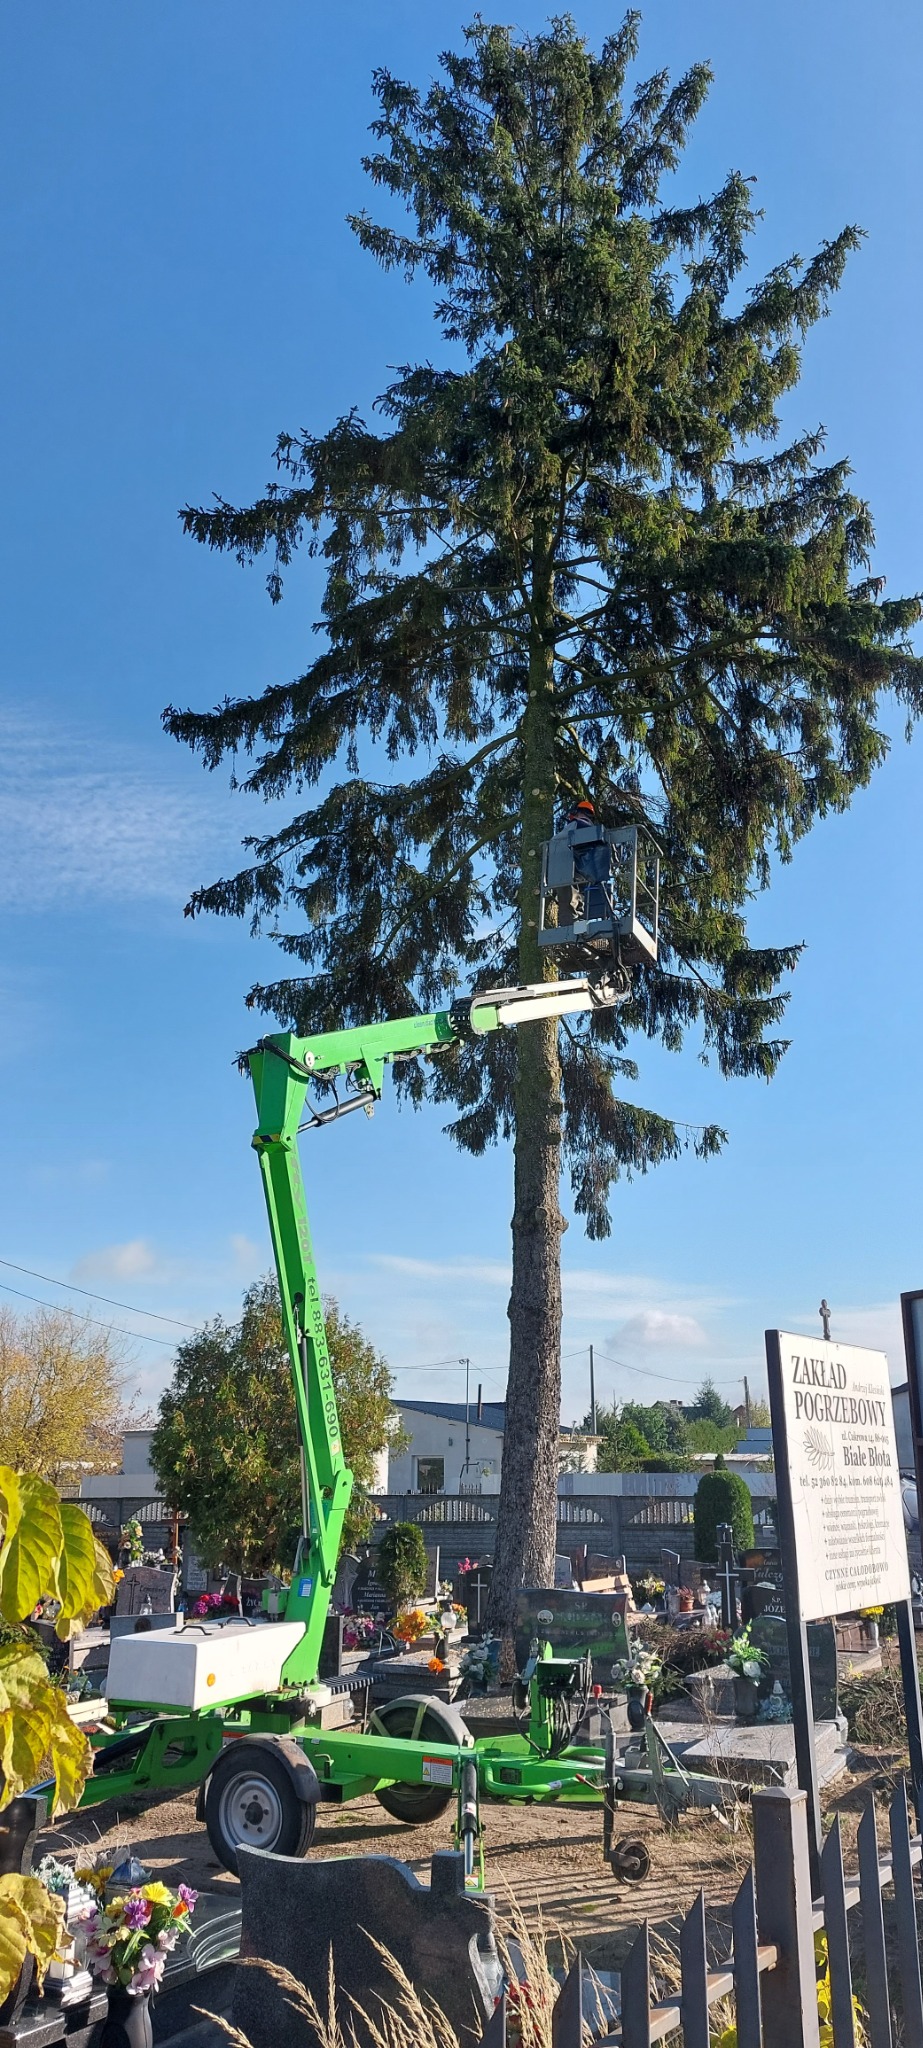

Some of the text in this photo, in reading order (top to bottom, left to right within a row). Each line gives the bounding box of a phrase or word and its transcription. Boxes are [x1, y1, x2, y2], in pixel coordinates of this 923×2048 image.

[791, 1355, 847, 1390] ZAKŁAD
[794, 1390, 886, 1427] POGRZEBOWY
[868, 1446, 892, 1467] Błota
[799, 1474, 810, 1487] tel.
[825, 1561, 889, 1581] CZYNNE CAŁODOBOWO
[763, 1603, 786, 1614] JÓZE
